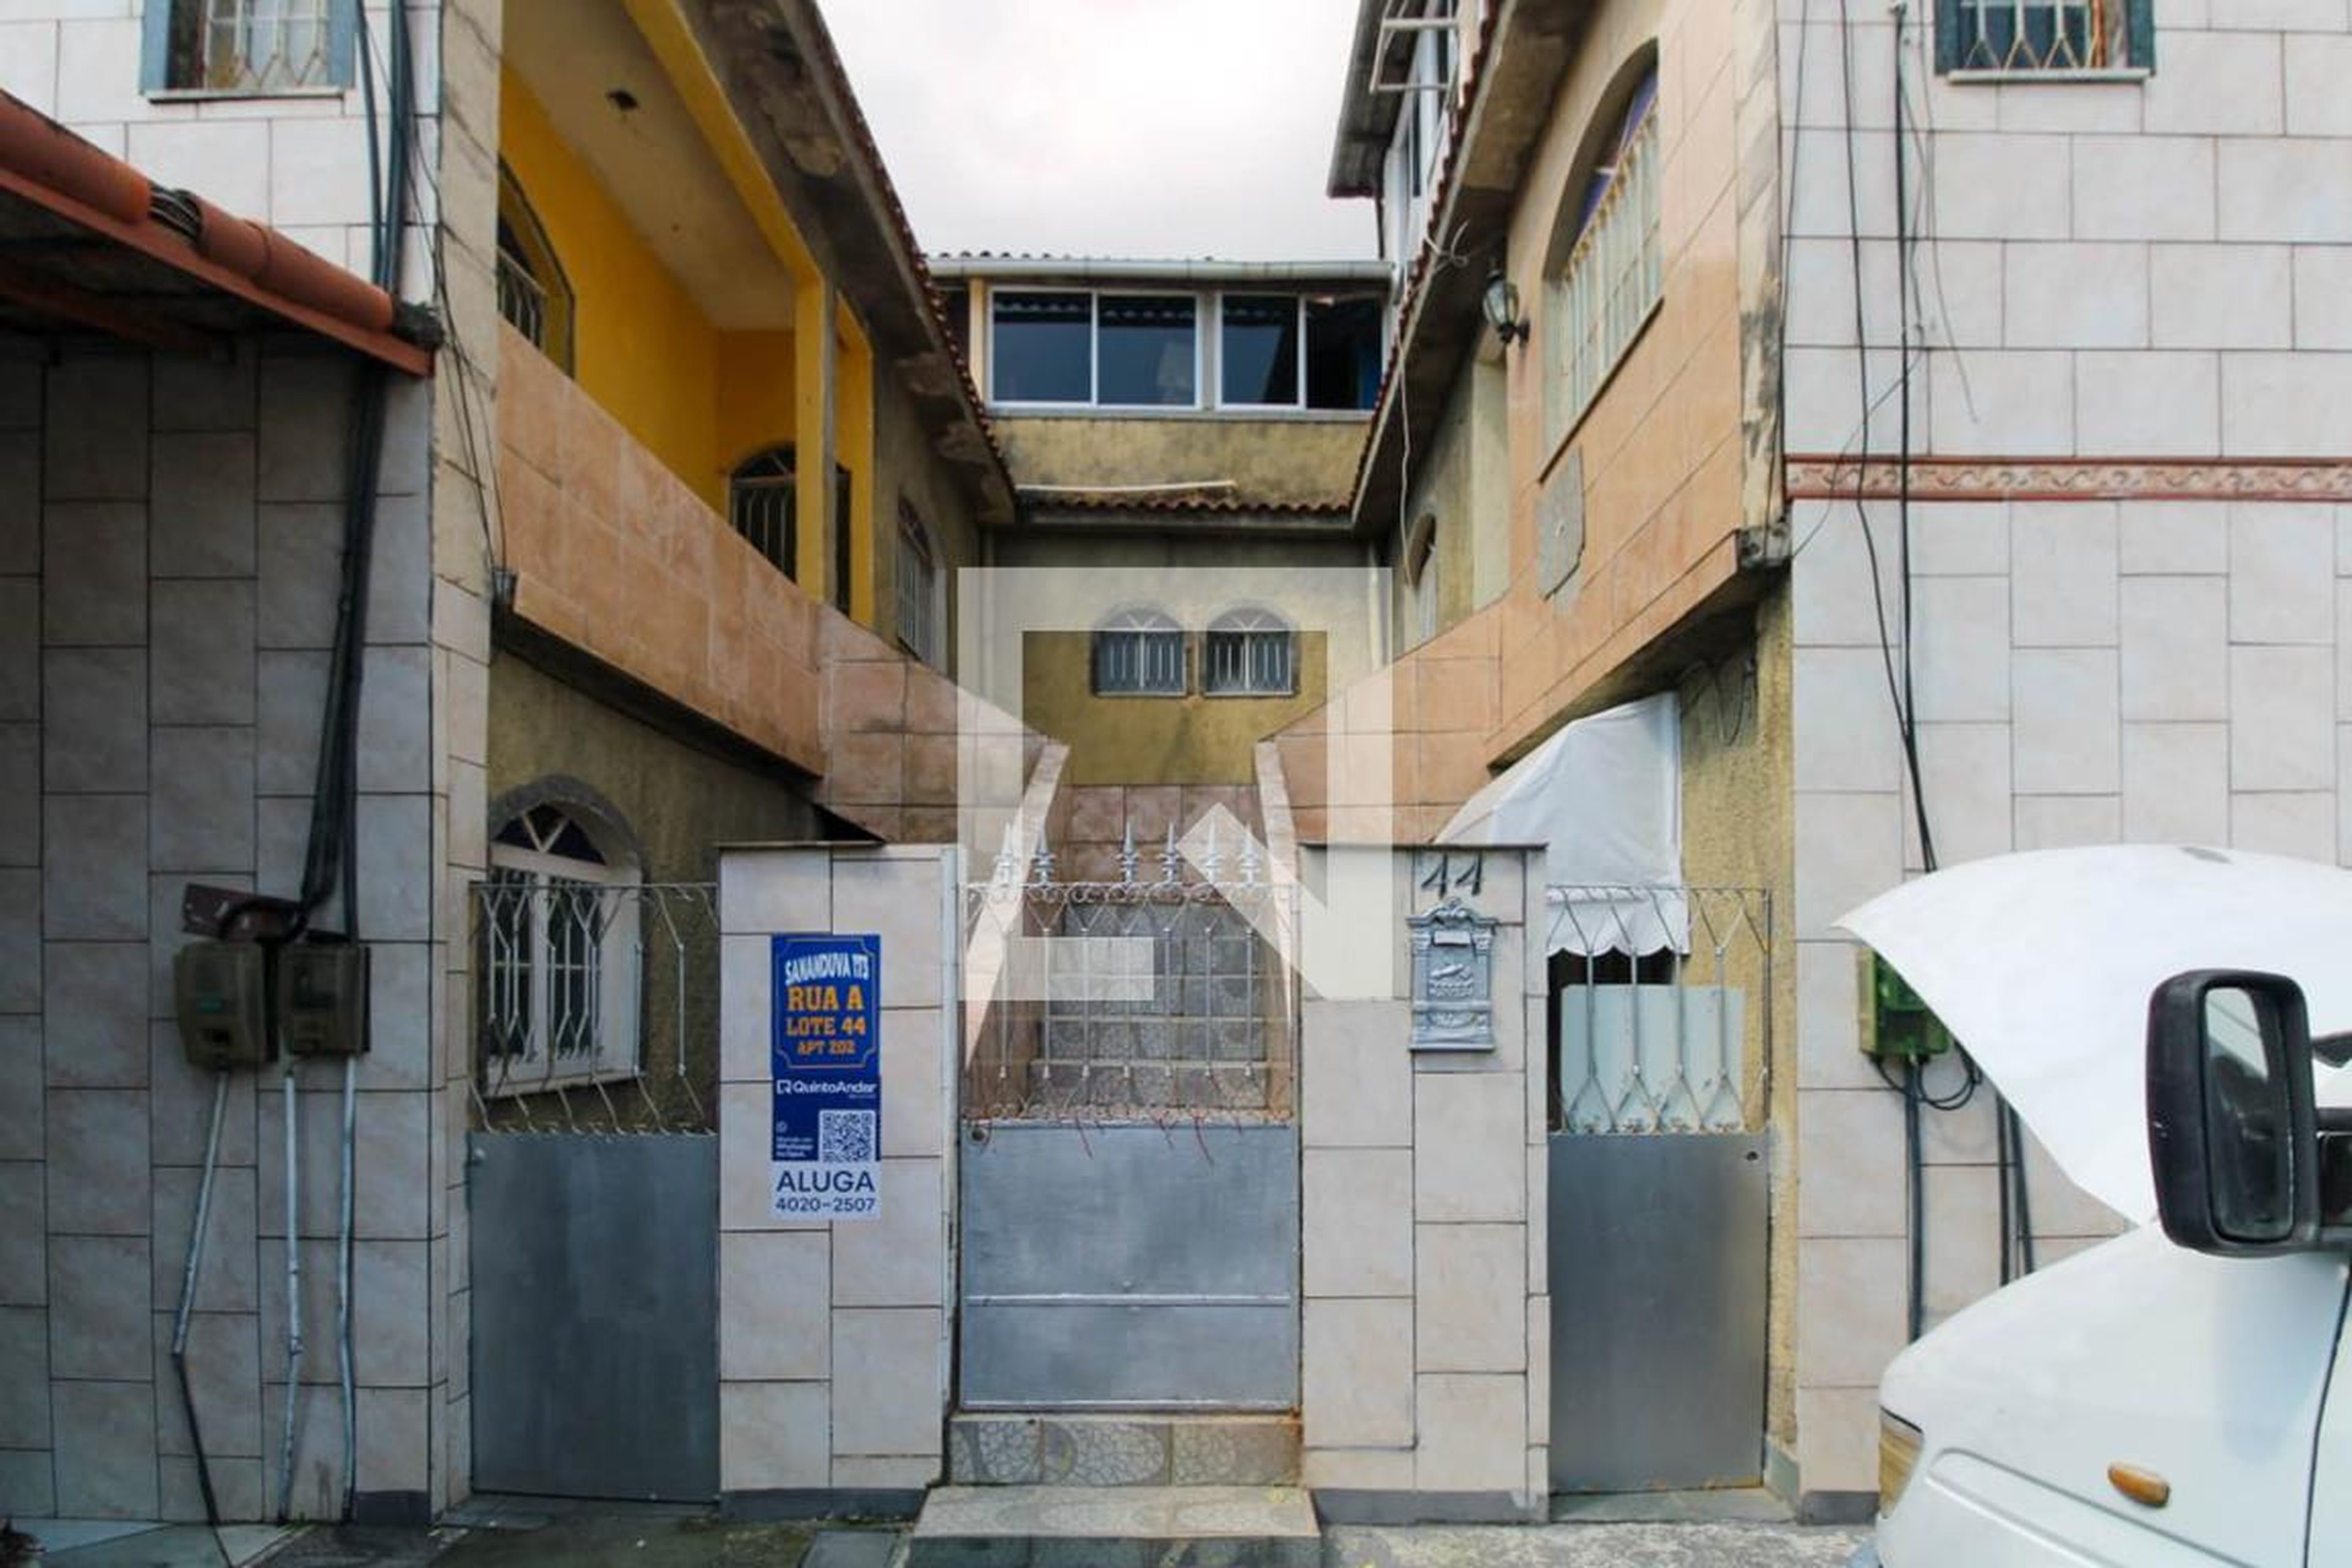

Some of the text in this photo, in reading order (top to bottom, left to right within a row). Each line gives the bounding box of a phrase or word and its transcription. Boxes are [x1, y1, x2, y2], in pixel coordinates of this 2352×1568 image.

[1421, 850, 1483, 900] 44
[788, 985, 864, 1011] RUA A
[786, 1017, 866, 1036] LOTE 44
[797, 1040, 824, 1055] APT
[793, 1080, 876, 1094] QuintoAndar
[776, 1170, 875, 1193] ALUGA
[775, 1197, 875, 1212] 4020-2507
